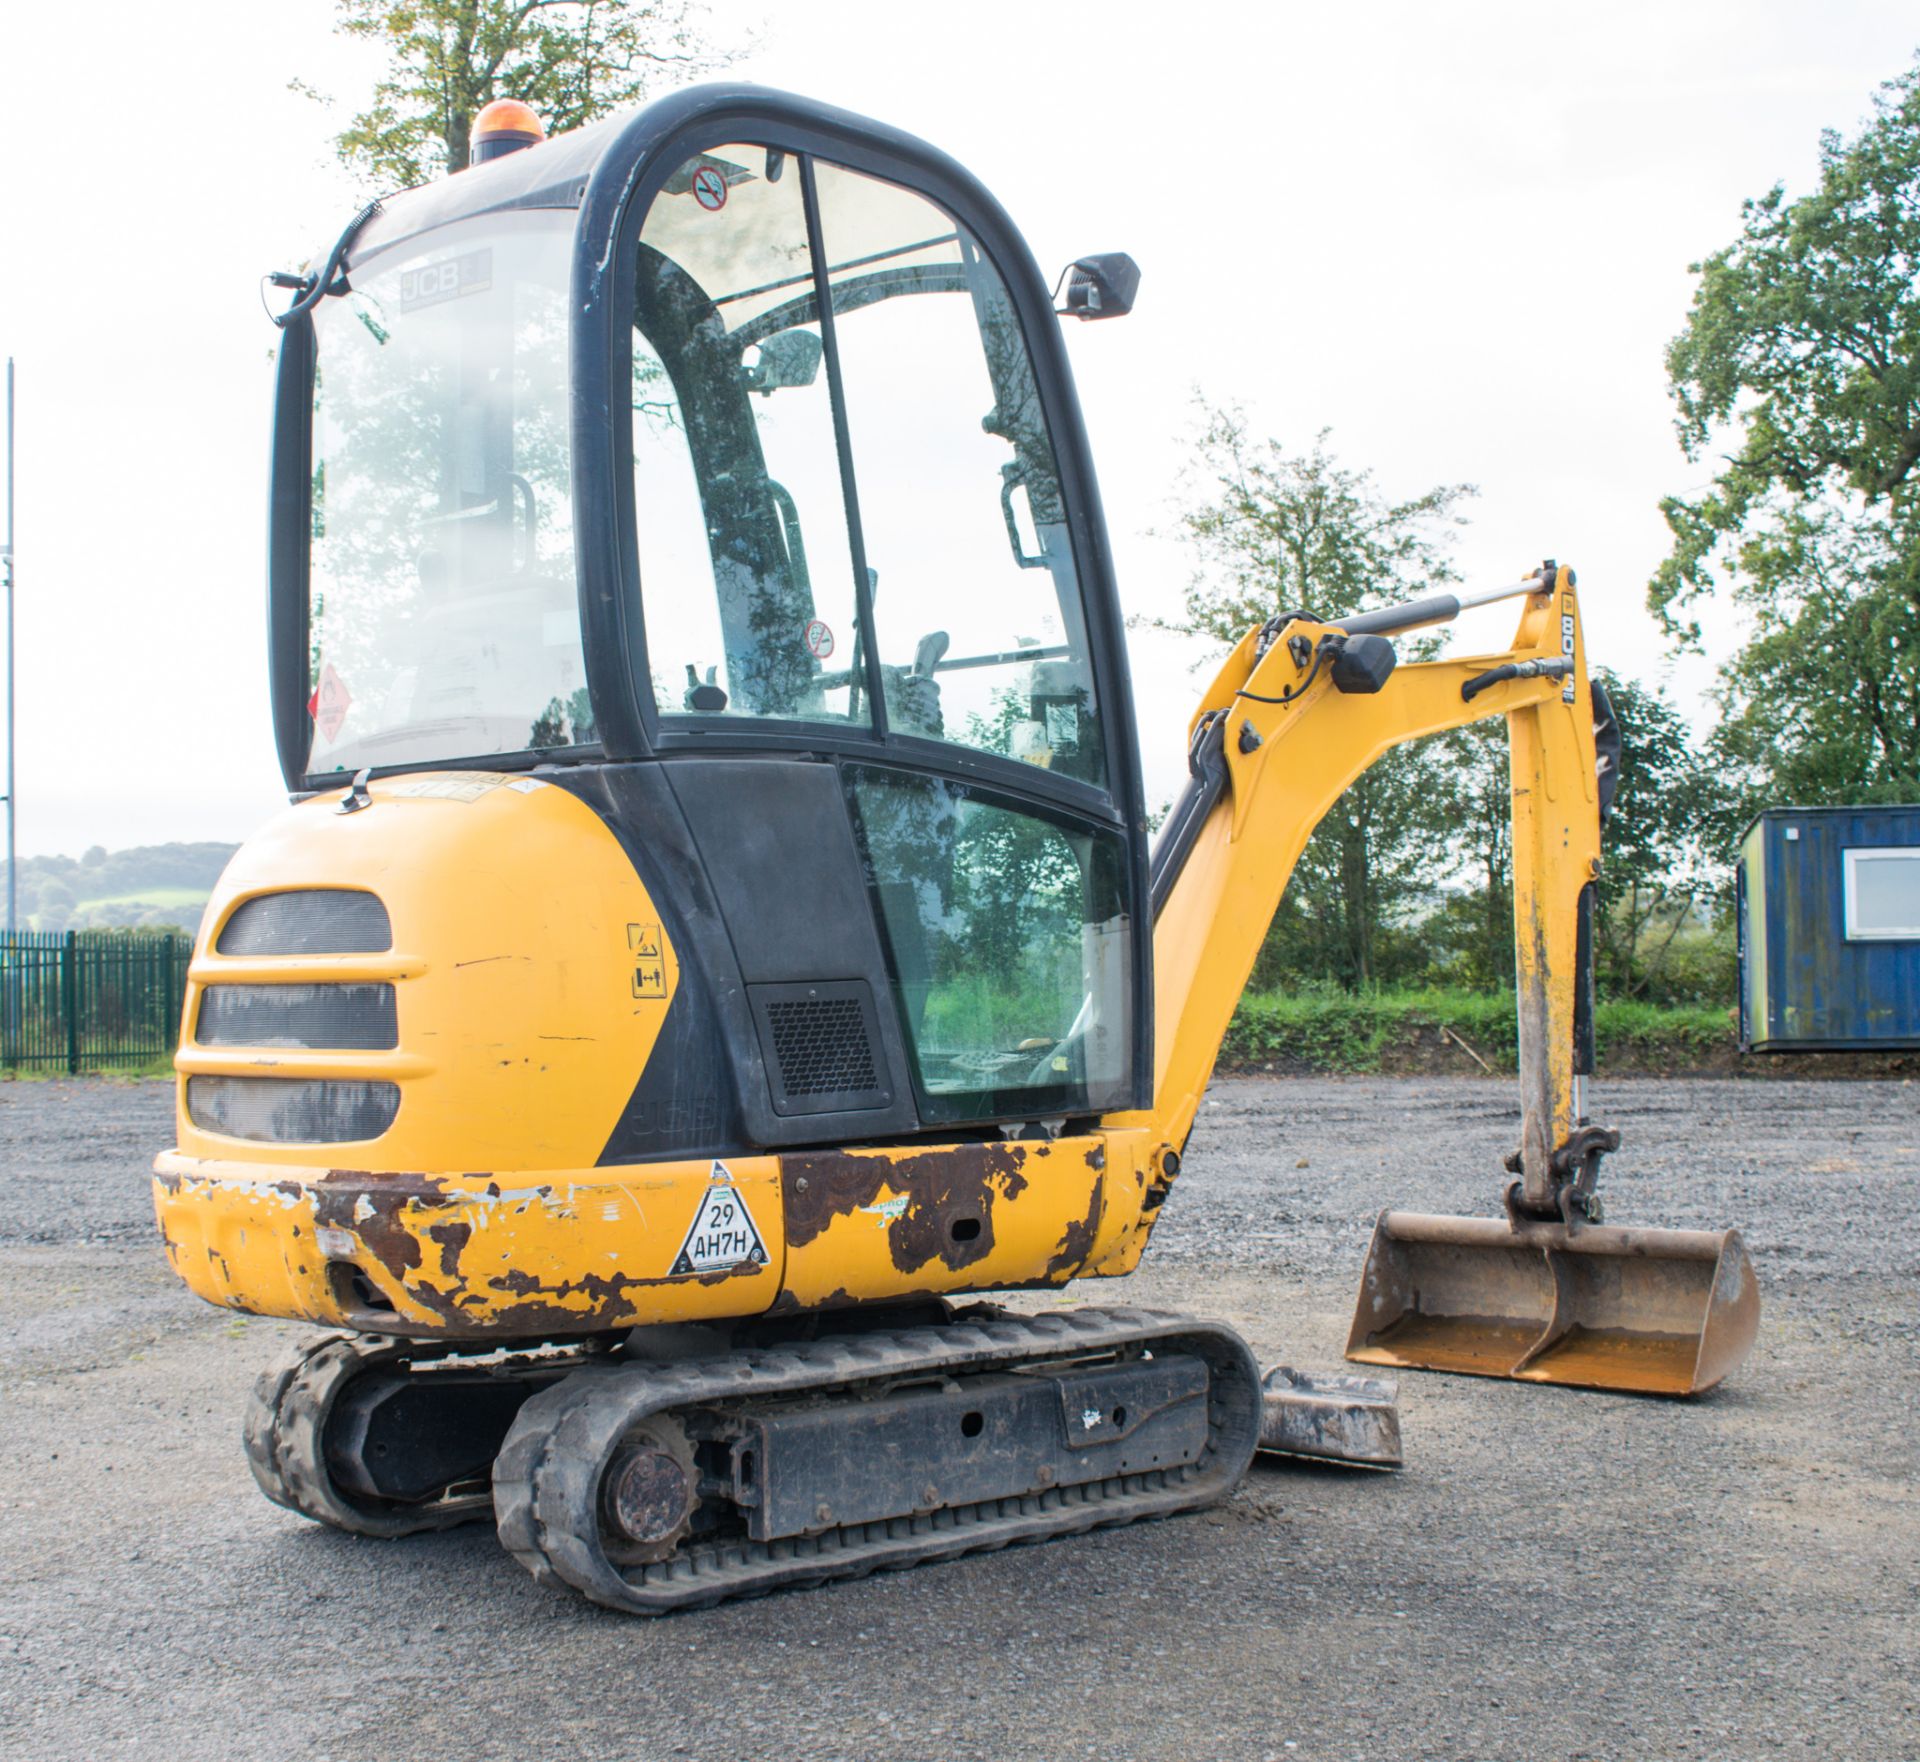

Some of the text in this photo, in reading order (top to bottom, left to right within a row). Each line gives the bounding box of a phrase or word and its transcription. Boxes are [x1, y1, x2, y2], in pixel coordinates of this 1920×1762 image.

[402, 262, 459, 302] JCB
[631, 1099, 717, 1135] JCB
[710, 1203, 734, 1229] 29
[694, 1230, 746, 1258] AH7H
